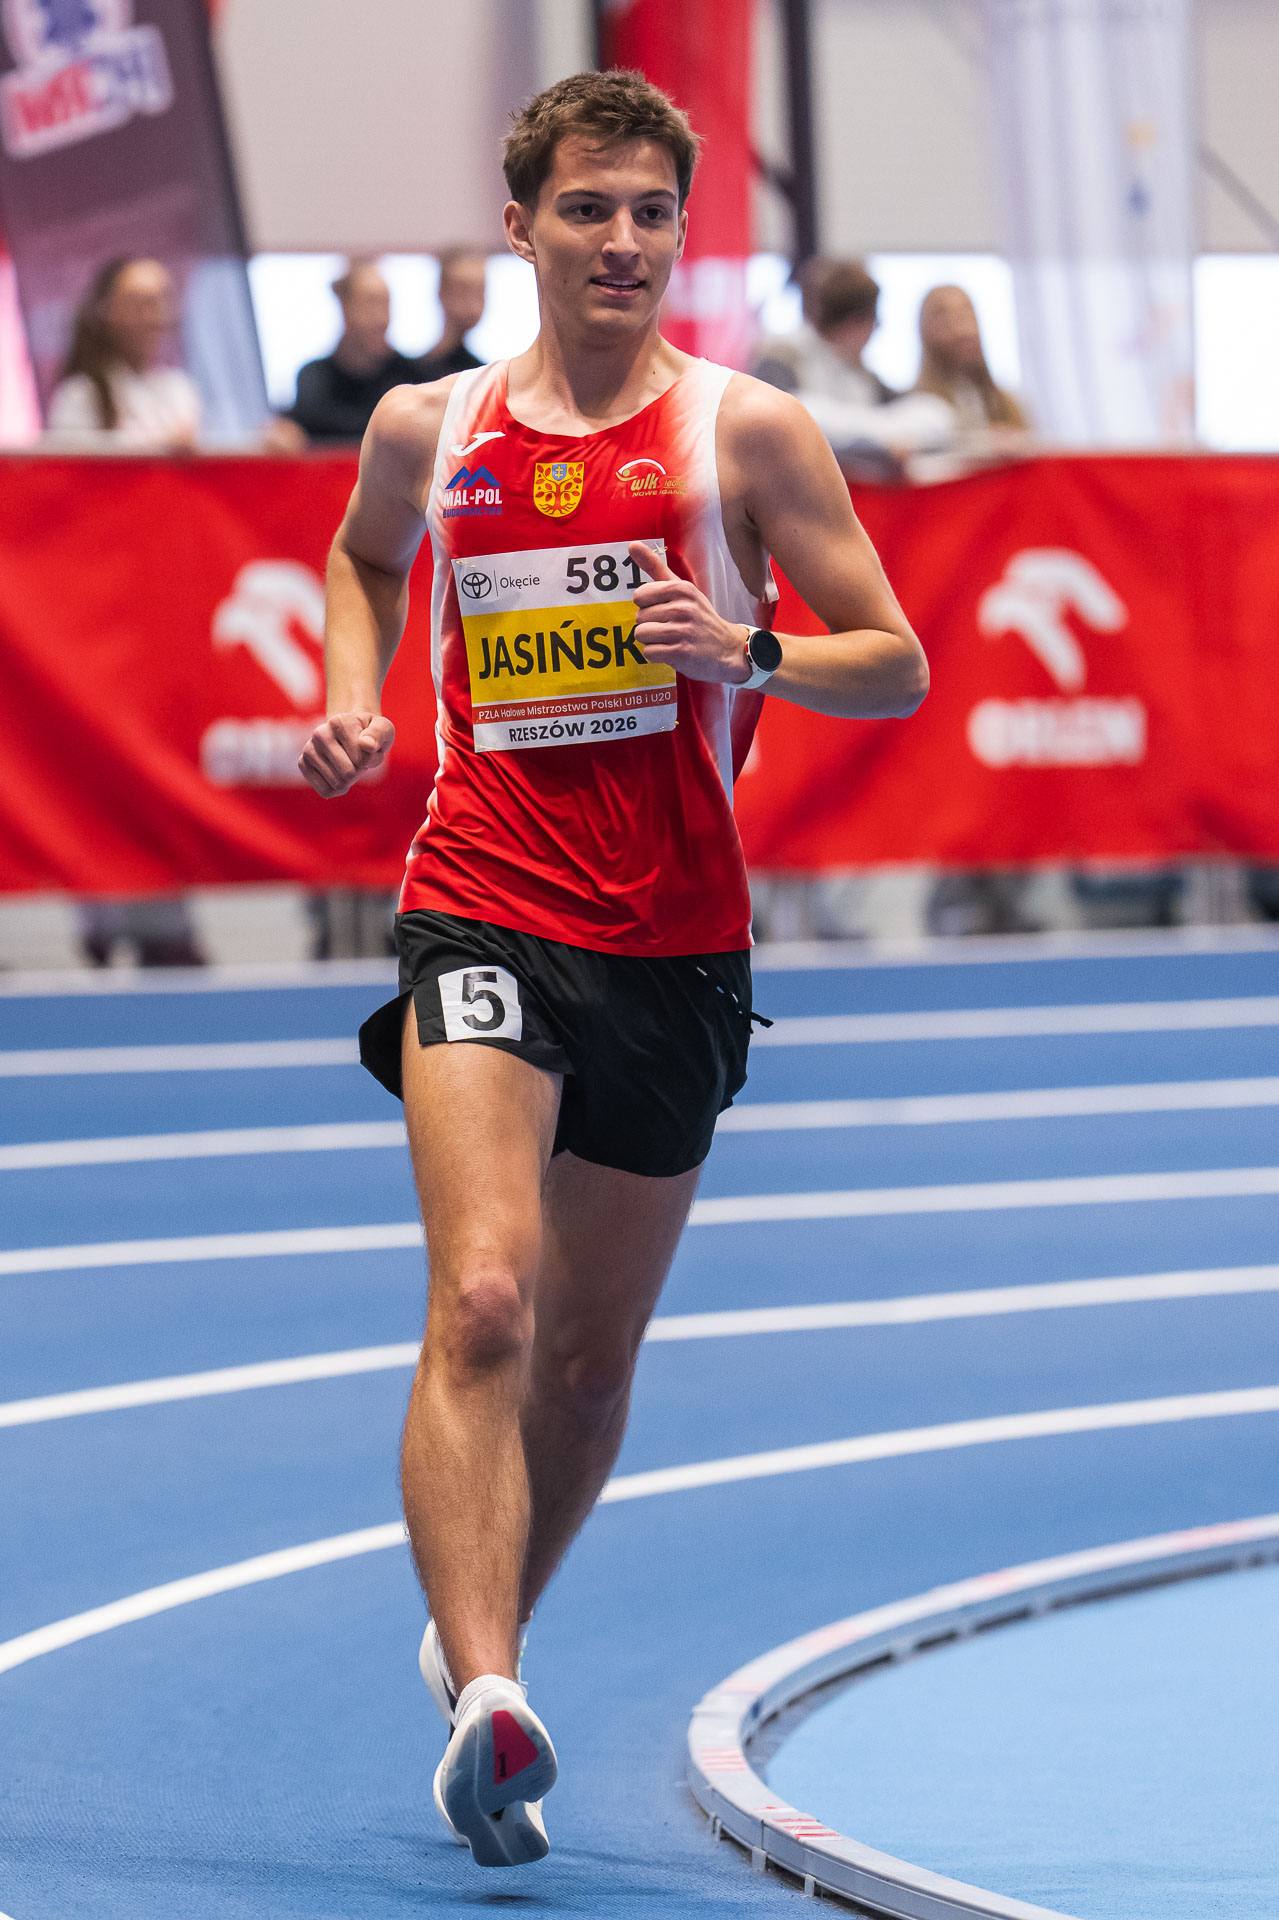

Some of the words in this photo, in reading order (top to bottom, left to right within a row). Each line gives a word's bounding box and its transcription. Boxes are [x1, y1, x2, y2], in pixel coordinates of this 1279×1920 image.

[443, 488, 503, 507] MAL-POL
[442, 506, 503, 519] BUDOWNICTWO
[499, 575, 541, 590] Okęcie
[565, 554, 648, 595] 581
[478, 619, 649, 680] JASIŃSK
[478, 710, 500, 721] PZLA
[500, 708, 526, 718] Halowe
[526, 702, 589, 716] Mistrzostwa
[591, 698, 623, 710] Polski
[624, 695, 642, 706] U18
[644, 694, 648, 704] i
[651, 691, 672, 703] U20
[508, 720, 586, 743] RZESZÓW
[590, 715, 638, 736] 2026
[460, 970, 507, 1031] 5
